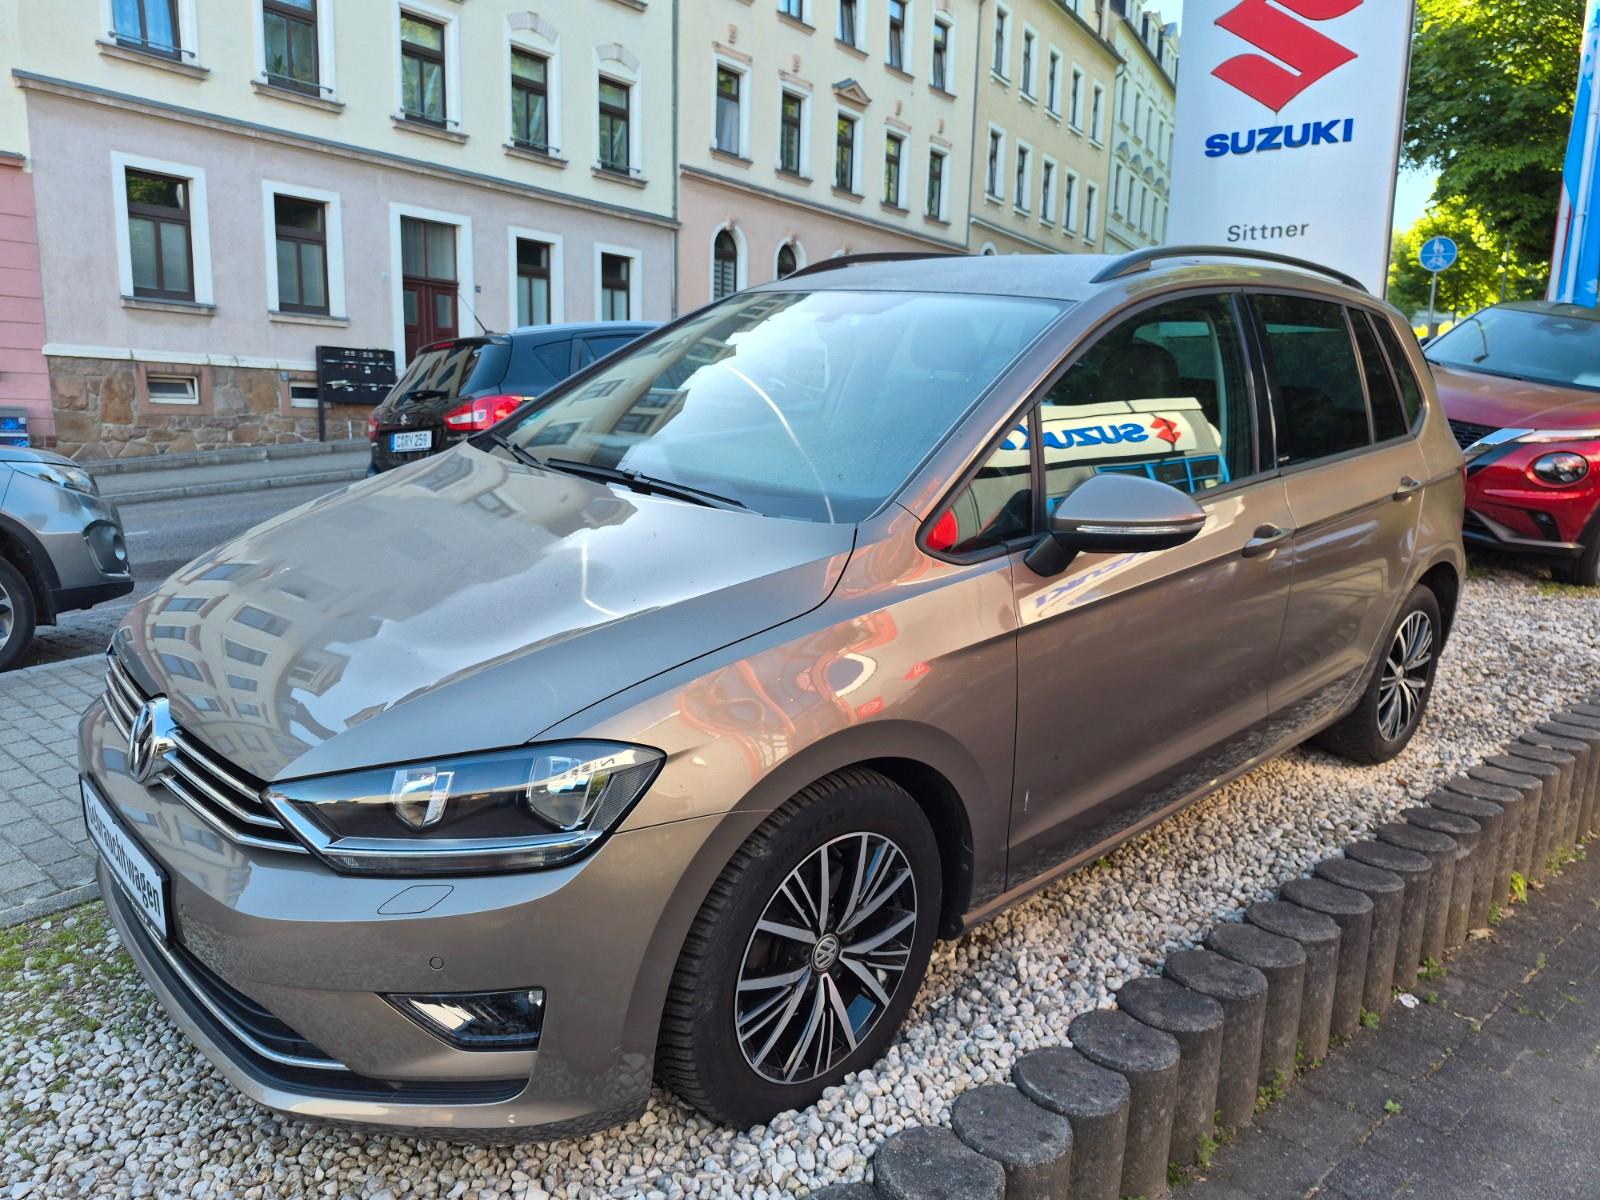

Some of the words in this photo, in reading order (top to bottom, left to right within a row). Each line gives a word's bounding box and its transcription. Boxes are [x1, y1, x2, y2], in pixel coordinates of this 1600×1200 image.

[1204, 118, 1354, 158] SUZUKI
[1226, 223, 1310, 242] Sittner
[85, 792, 161, 918] Gebrauchtwagen
